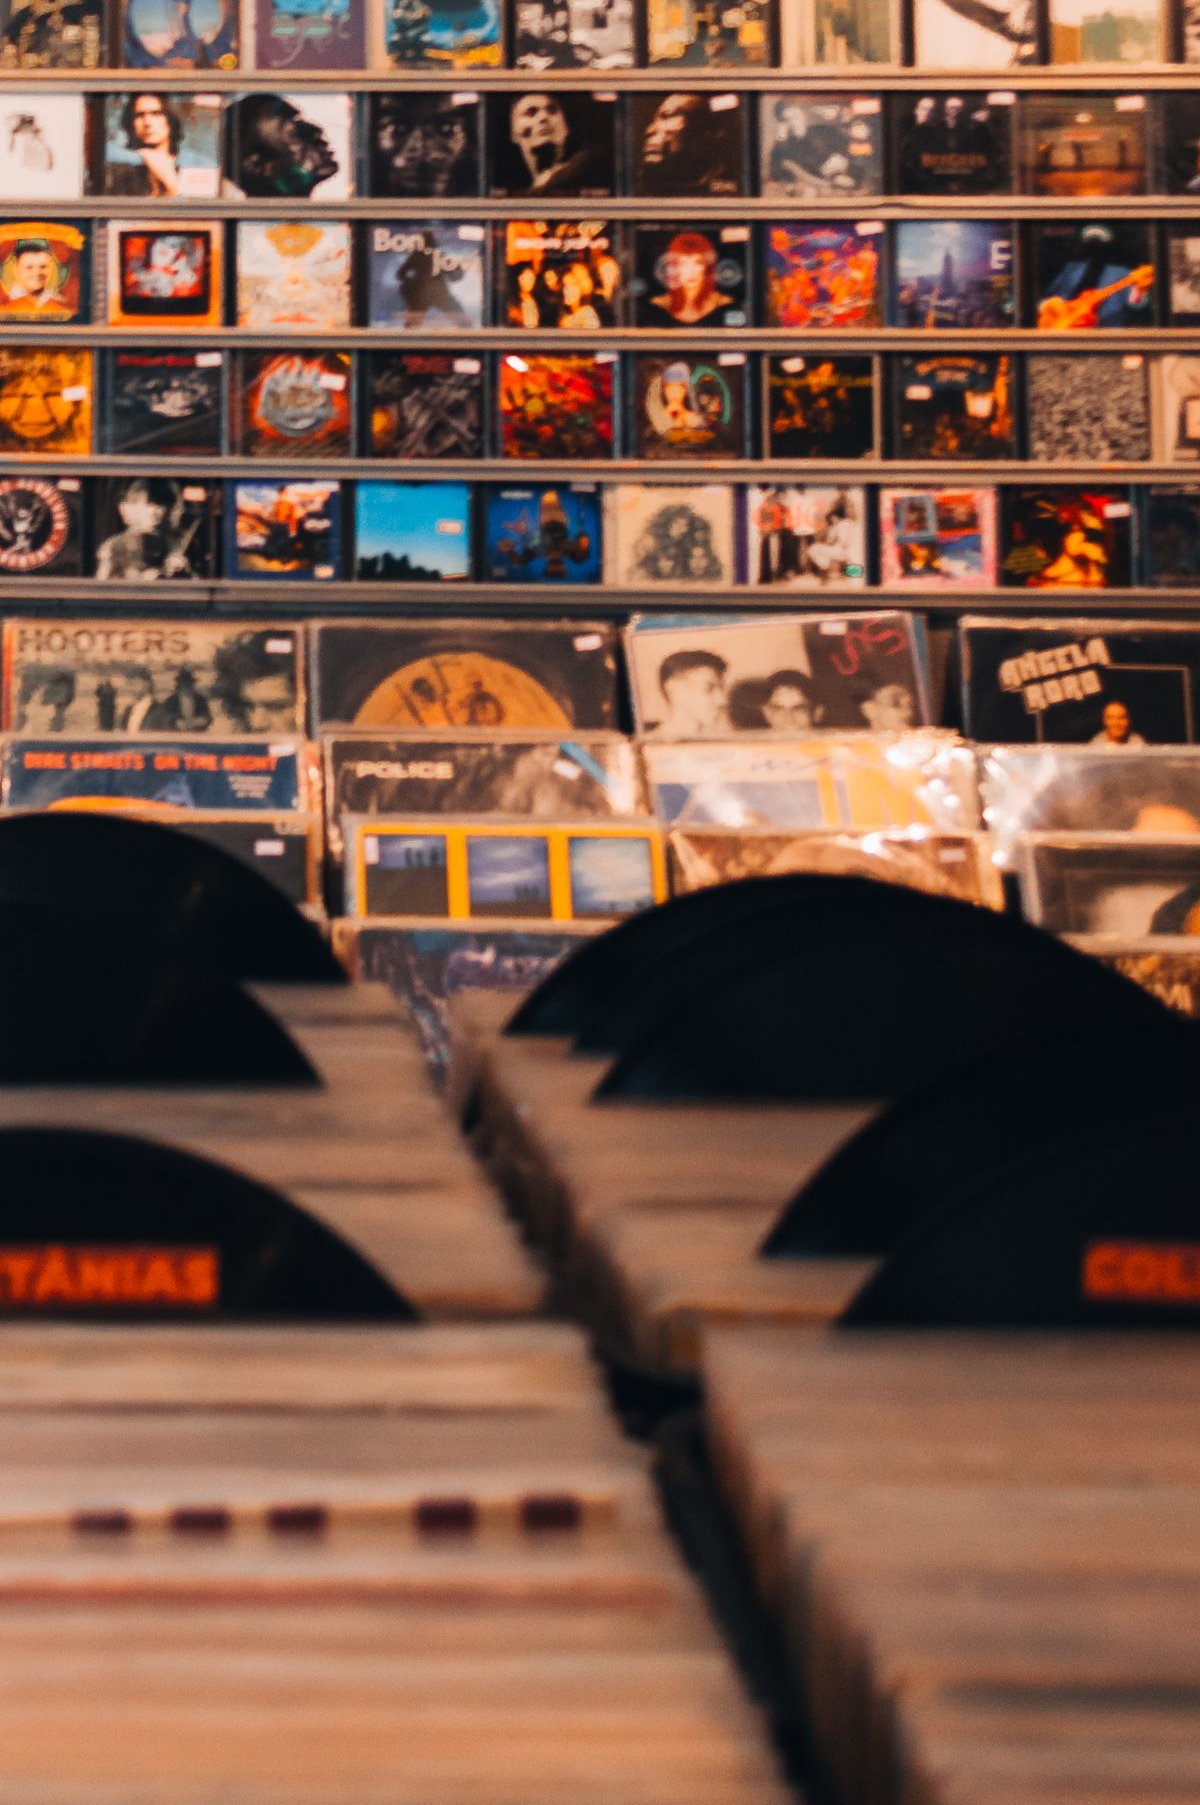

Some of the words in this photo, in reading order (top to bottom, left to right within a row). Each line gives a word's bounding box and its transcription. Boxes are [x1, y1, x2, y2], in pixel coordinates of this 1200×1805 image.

[373, 227, 425, 253] Bon
[17, 628, 191, 655] HOOTERS
[355, 760, 454, 780] POLICE
[1084, 1242, 1200, 1300] COL
